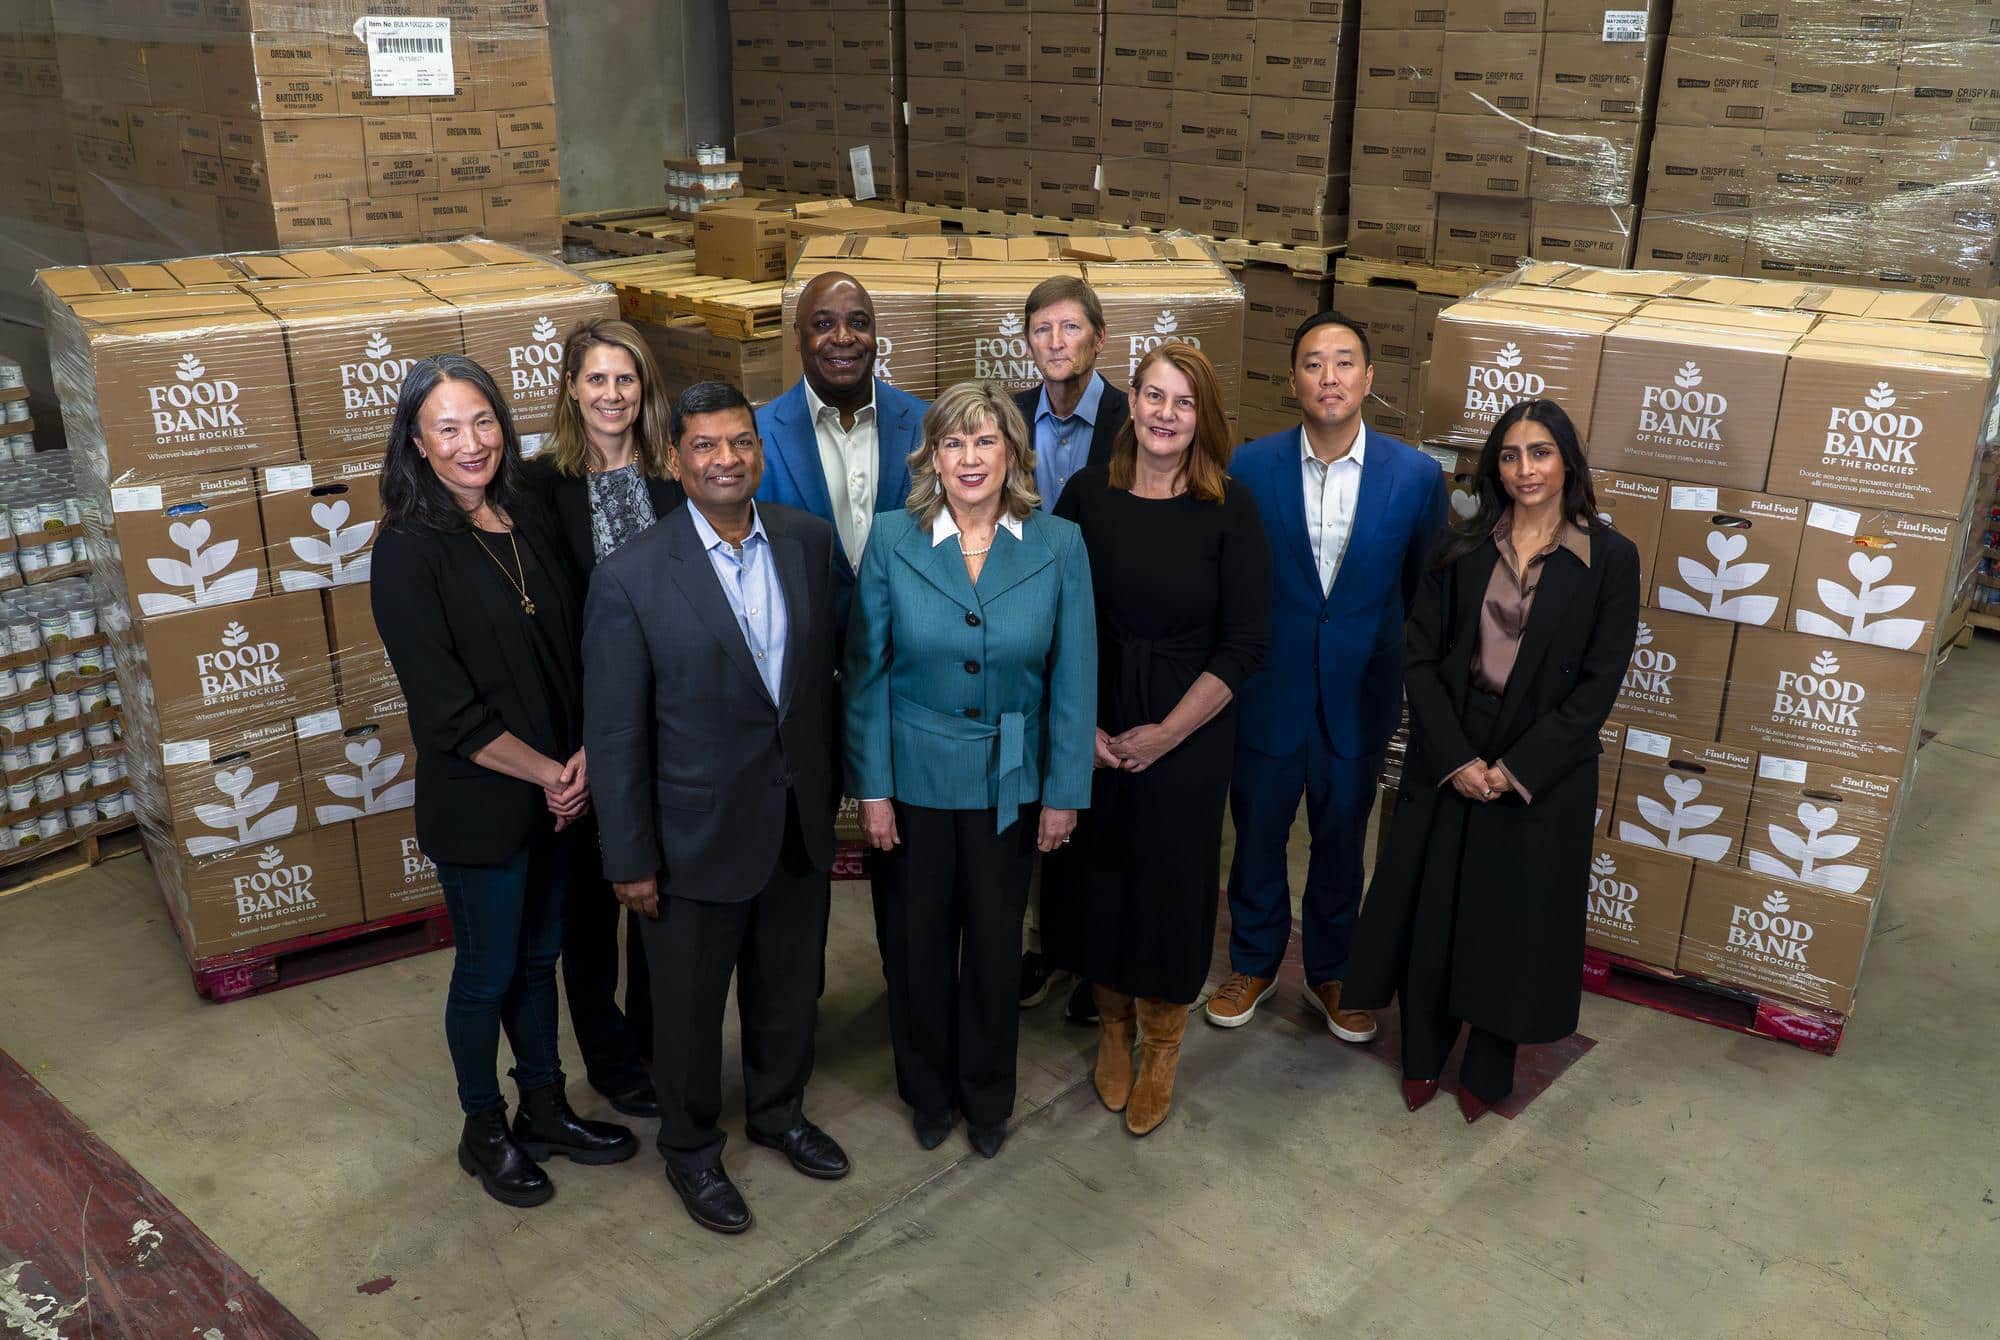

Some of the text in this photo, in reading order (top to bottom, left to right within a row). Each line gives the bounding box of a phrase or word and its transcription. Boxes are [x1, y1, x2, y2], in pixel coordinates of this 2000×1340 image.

[271, 49, 312, 59] OREGON TRAIL
[1314, 58, 1326, 66] RICE
[1485, 71, 1524, 81] CRISPY RICE
[1589, 73, 1631, 84] CRISPY RICE
[1714, 78, 1759, 88] CRISPY RICE
[1831, 83, 1860, 92] CRISPY
[1957, 88, 1989, 98] CRISPY
[276, 93, 324, 102] BARTLETT PEARS
[447, 128, 482, 136] OREGON TRAIL
[511, 120, 543, 132] OREGON TRAIL
[1476, 153, 1513, 164] CRISPY RICE
[1701, 167, 1745, 177] CRISPY RICE
[1845, 177, 1863, 185] RICE
[317, 218, 332, 226] TRAIL
[365, 211, 404, 220] OREGON TRAIL
[1386, 222, 1421, 233] CRISPY RICE
[1480, 230, 1516, 241] CRISPY RICE
[1574, 239, 1613, 250] CRISPY RICE
[1686, 251, 1729, 264] CRISPY RICE
[1920, 274, 1971, 288] CRISPY RICE
[509, 343, 563, 368] FOO
[975, 338, 1027, 358] FOO
[511, 366, 560, 390] BAN
[1468, 365, 1544, 395] FOOD
[148, 381, 239, 410] FOOD
[343, 384, 401, 409] BAN
[1642, 386, 1728, 415] FOOD
[152, 404, 244, 434] BANK
[346, 411, 359, 419] OF
[362, 409, 381, 417] THE
[1464, 412, 1496, 423] OF THE
[1638, 409, 1722, 440] BANK
[1828, 407, 1923, 438] FOOD
[157, 428, 246, 445] OF THE ROCKIES
[1637, 434, 1721, 451] OF THE ROCKIES
[1624, 448, 1654, 457] Wherever
[1824, 432, 1918, 464] BANK
[343, 463, 361, 472] Find
[1822, 457, 1915, 475] OF THE ROCKIES
[200, 477, 247, 490] Find Food
[1799, 469, 1822, 479] Donde
[1859, 476, 1894, 488] encuentre
[1615, 480, 1636, 490] Find
[1637, 482, 1659, 494] Food
[1822, 483, 1858, 492] estaremos
[1751, 500, 1773, 511] Find
[1774, 503, 1799, 515] Food
[1897, 521, 1948, 534] Find Food
[196, 642, 280, 675] FOOD
[1631, 649, 1676, 673] OD
[200, 662, 284, 697] BANK
[1777, 670, 1865, 703] FOOD
[204, 684, 286, 705] OF THE ROCKIES
[1629, 690, 1671, 704] ROCKIES
[1773, 693, 1861, 727] BANK
[265, 724, 286, 735] Food
[1771, 715, 1858, 737] OF THE ROCKIES
[1705, 749, 1726, 759] Find
[1727, 753, 1749, 764] Food
[1842, 776, 1863, 787] Find
[1865, 780, 1889, 793] Food
[404, 855, 437, 875] BA
[233, 865, 312, 896] FOOD
[236, 883, 317, 916] BANK
[255, 912, 273, 921] THE
[276, 902, 317, 916] ROCKIES
[1731, 905, 1813, 942] FOOD
[1727, 925, 1808, 963] BANK
[1725, 945, 1806, 971] OF THE ROCKIES
